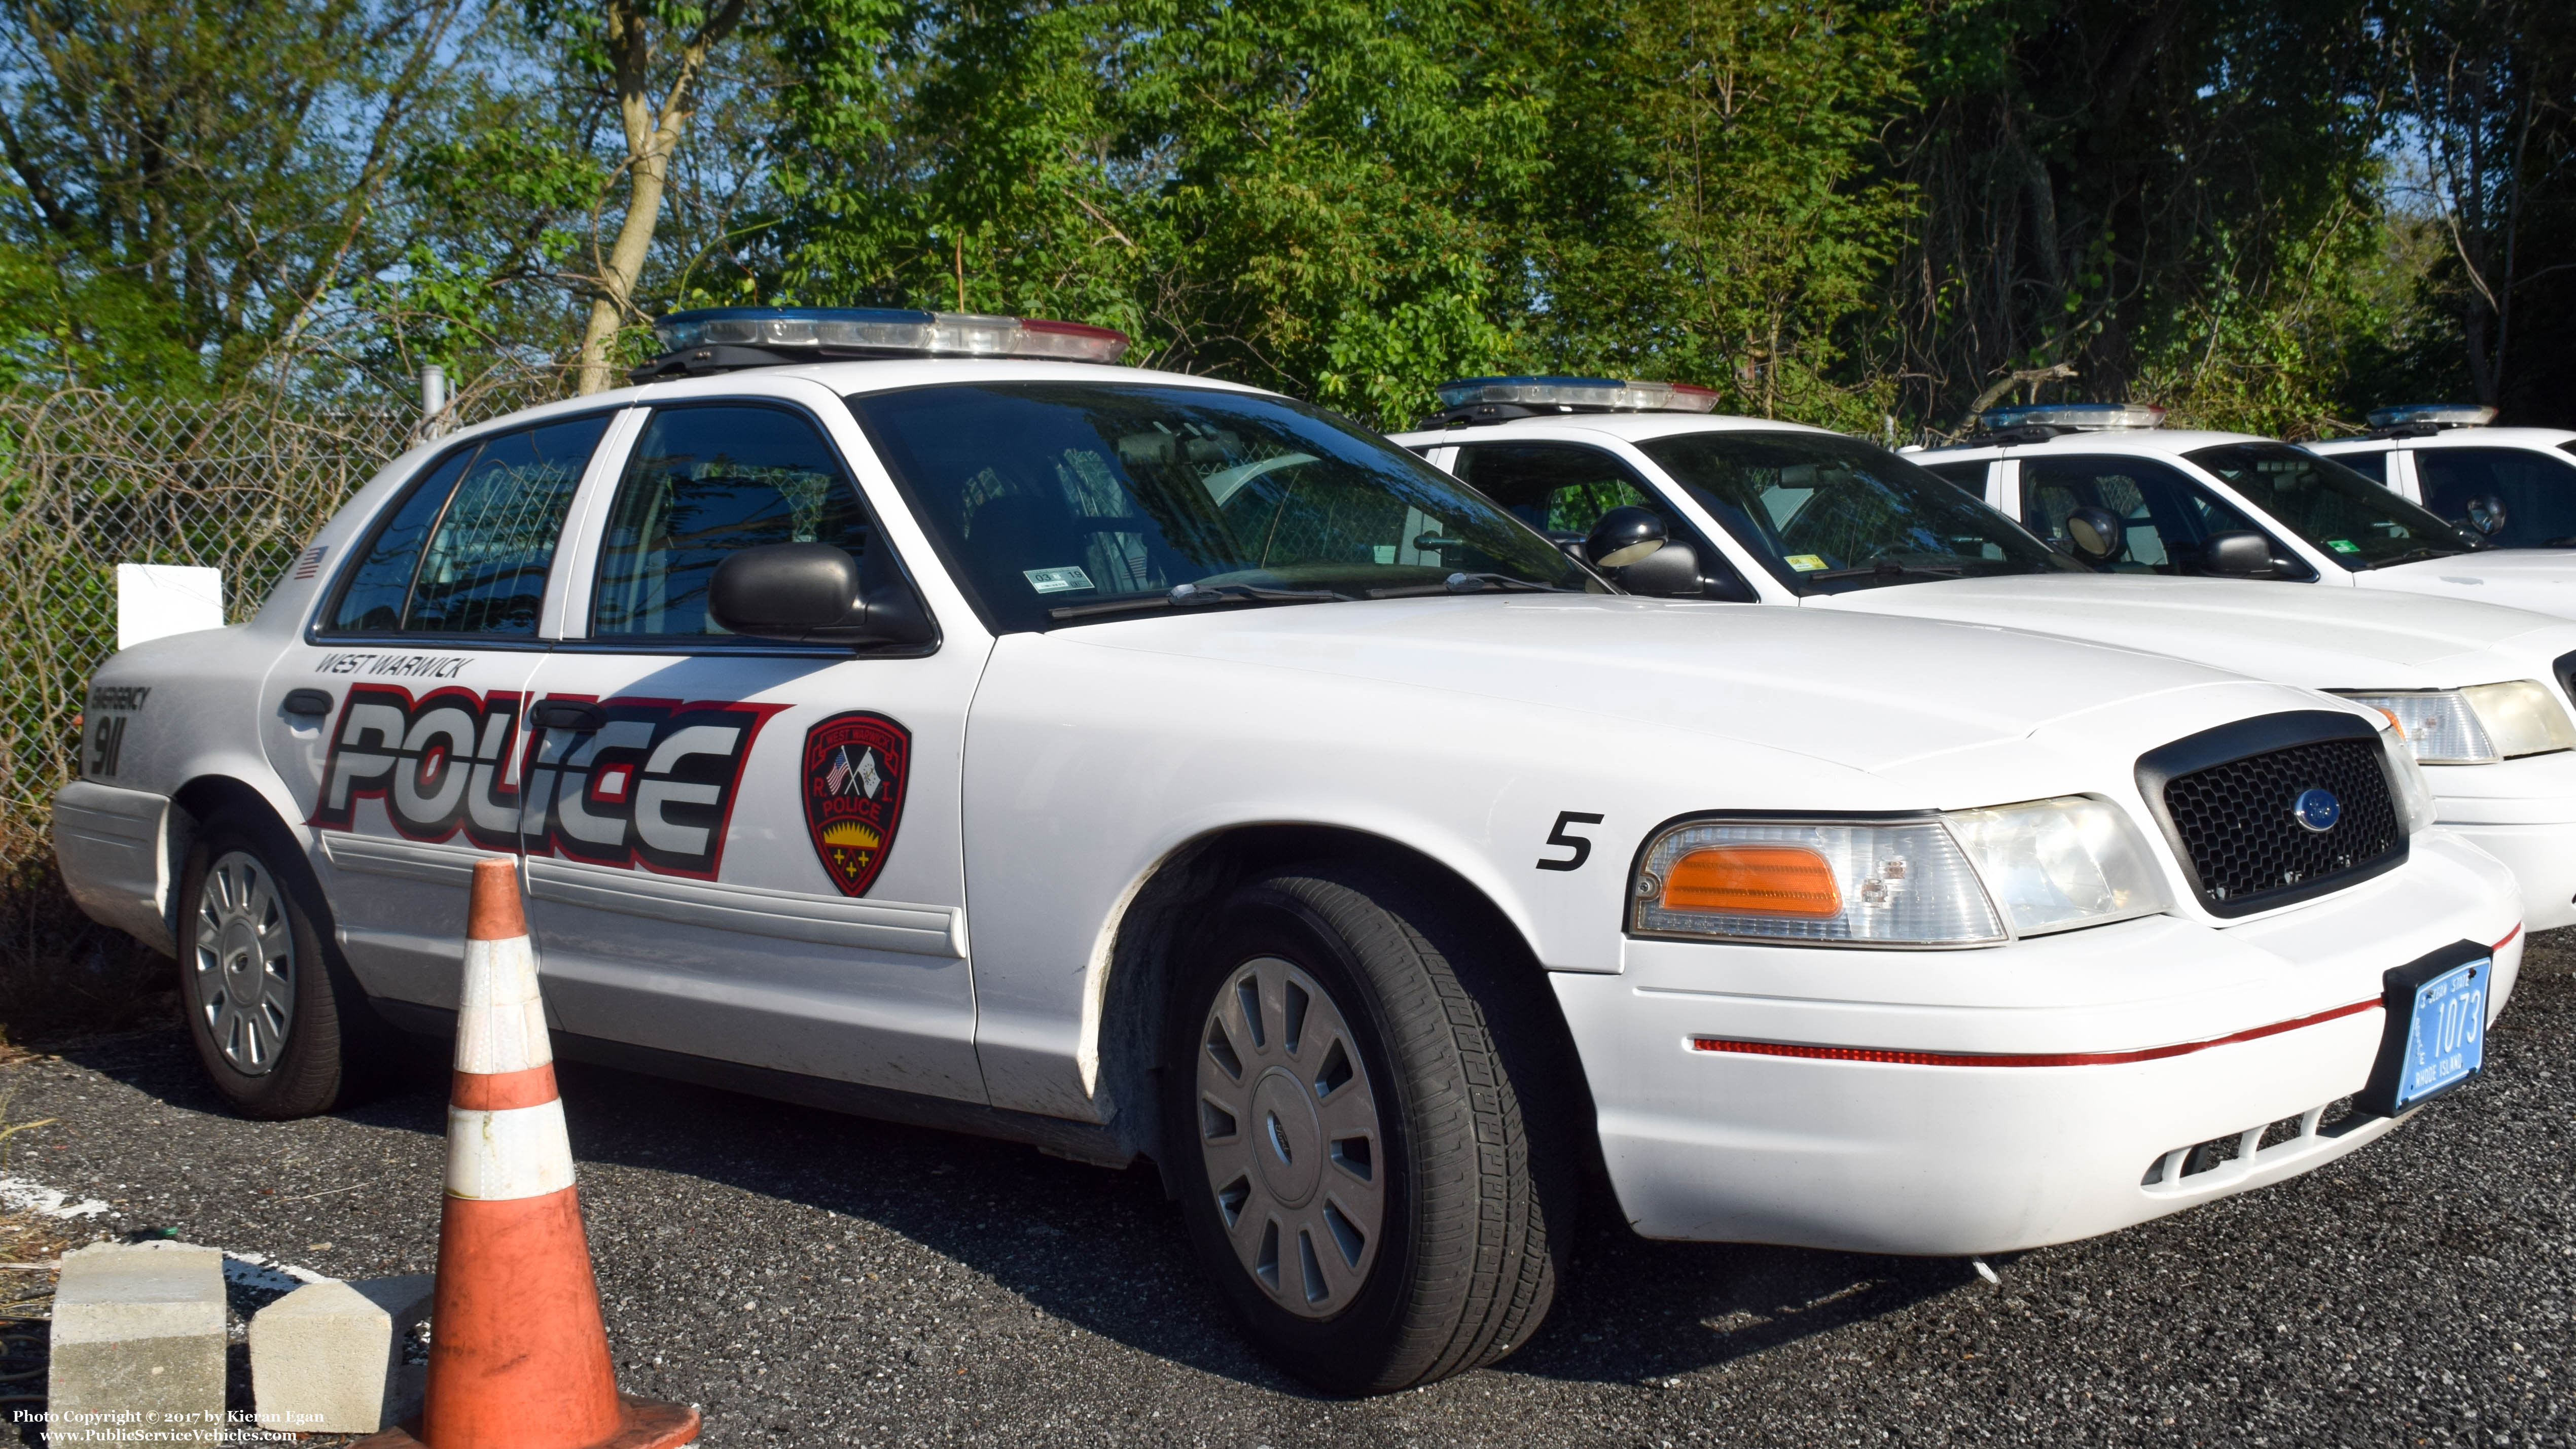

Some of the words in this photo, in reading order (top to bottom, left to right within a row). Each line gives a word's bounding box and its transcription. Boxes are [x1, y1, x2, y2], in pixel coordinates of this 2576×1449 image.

[1035, 574, 1051, 582] 03
[315, 653, 377, 674] WEST
[369, 654, 475, 679] WARWICK
[91, 717, 126, 776] 911
[826, 729, 849, 745] WEST
[852, 729, 890, 749] WARWICK
[317, 692, 756, 873] POLICE
[822, 796, 881, 822] POLICE
[1535, 810, 1605, 872] 5
[2435, 989, 2481, 1058] 1073
[2416, 1065, 2437, 1087] RHODE
[2440, 1053, 2462, 1077] ISLAND
